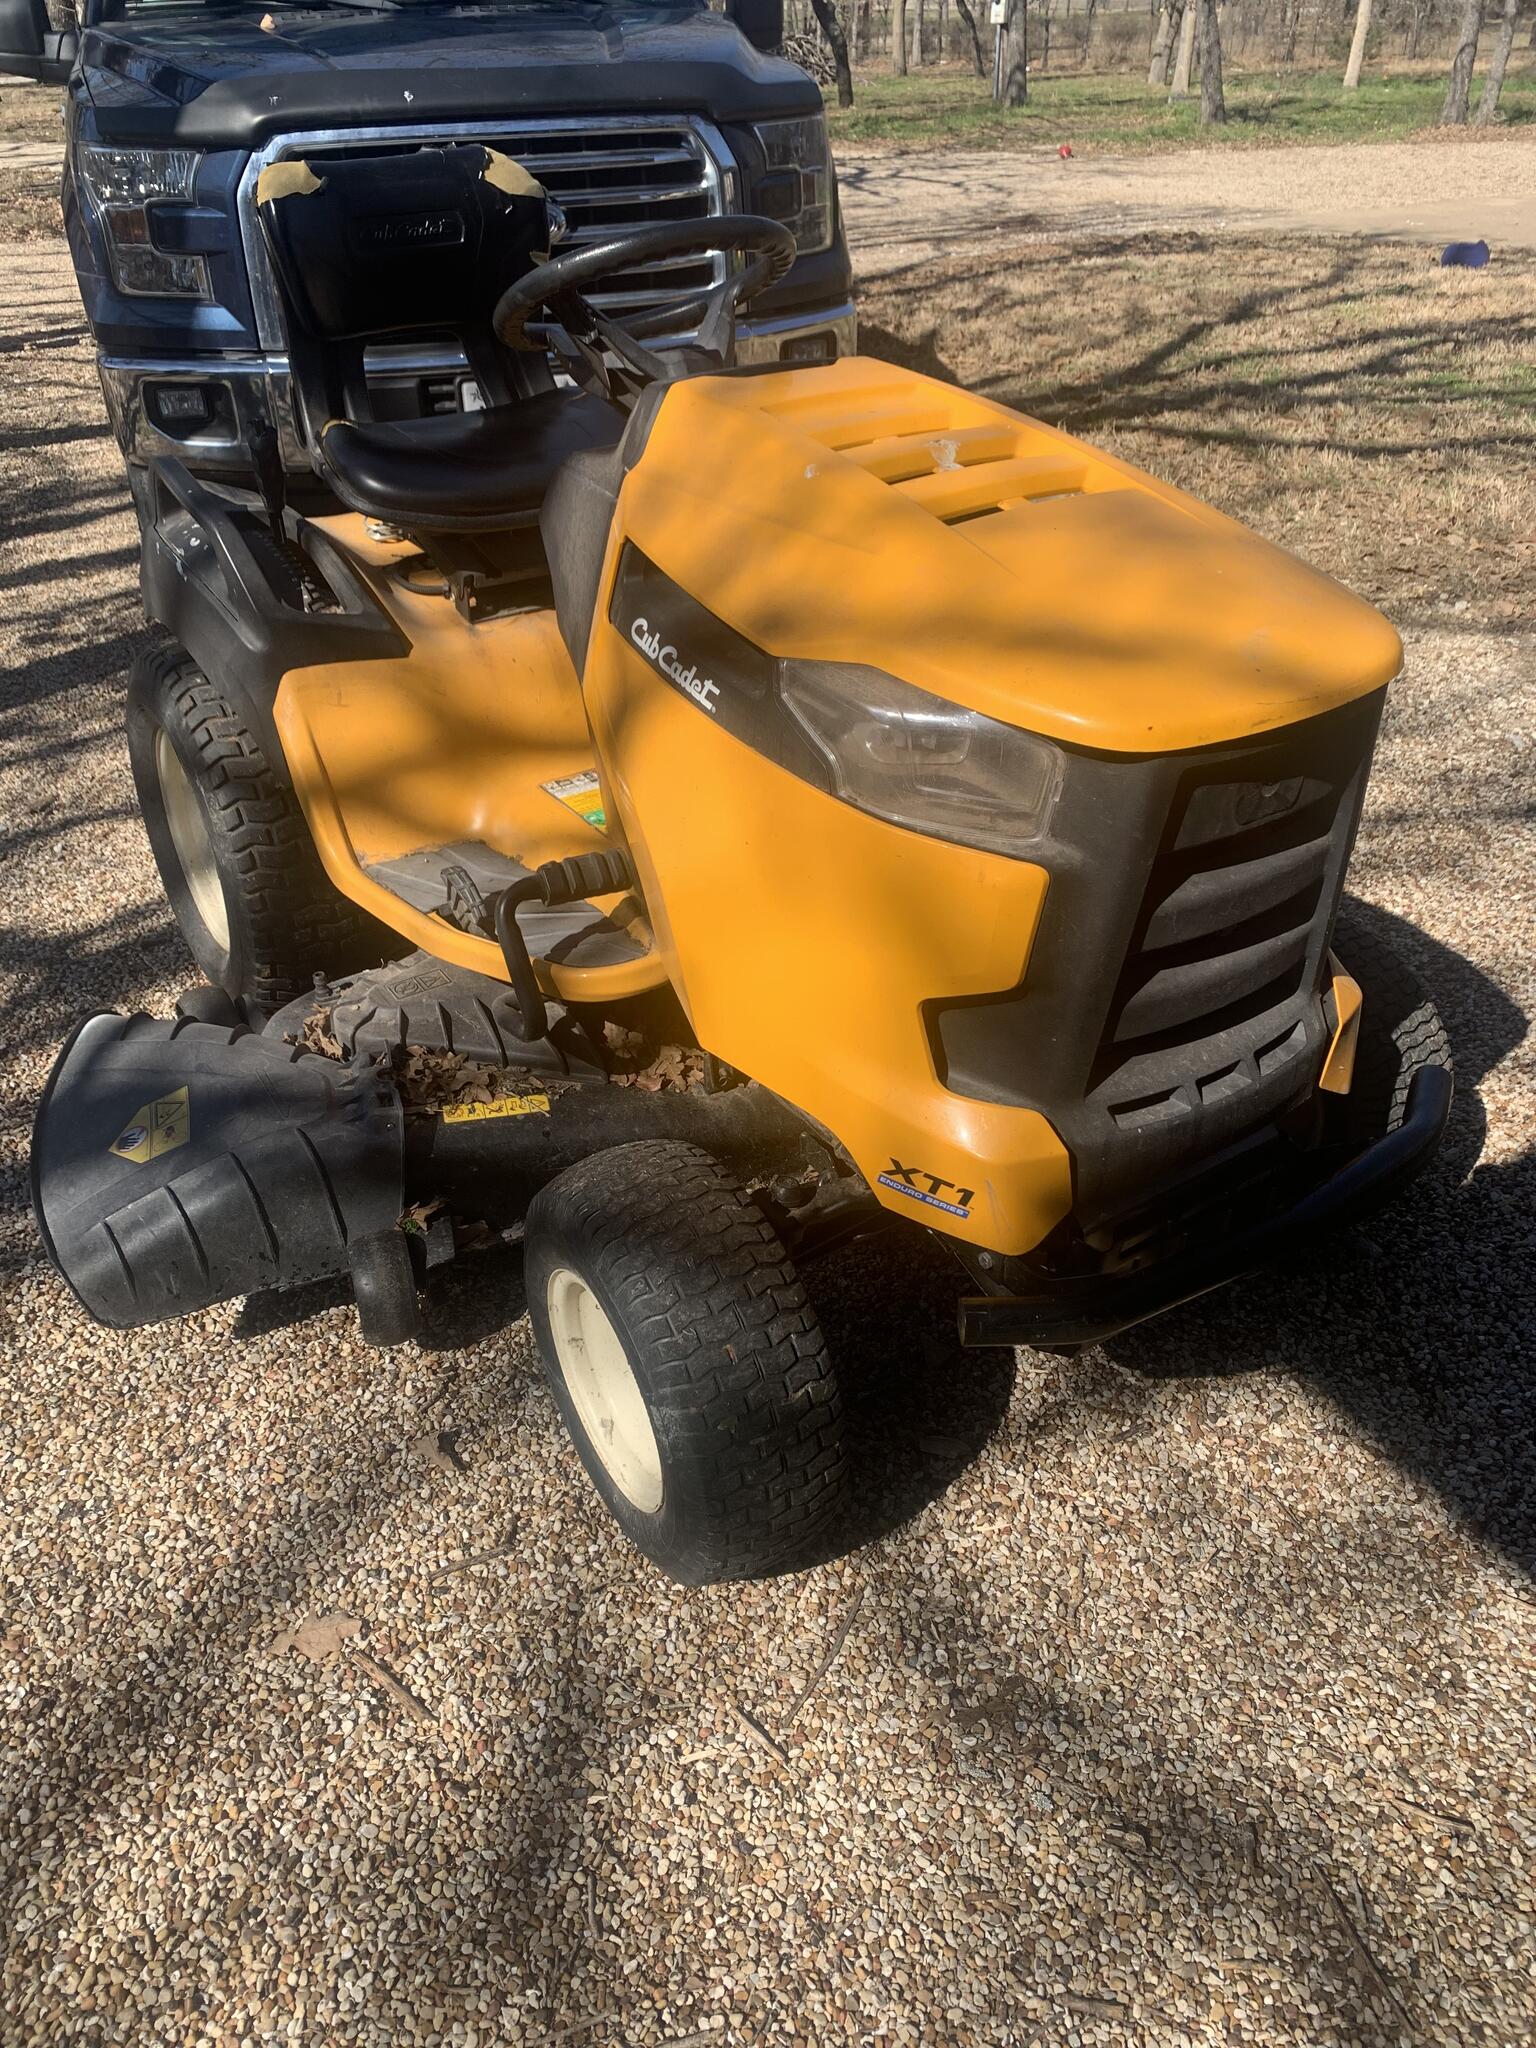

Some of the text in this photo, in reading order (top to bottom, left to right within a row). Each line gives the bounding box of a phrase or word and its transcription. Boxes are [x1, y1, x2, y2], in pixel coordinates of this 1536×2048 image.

[631, 618, 720, 710] Cub Cadet
[879, 1176, 965, 1216] ENDURO SERIES
[880, 1156, 976, 1207] XT1
